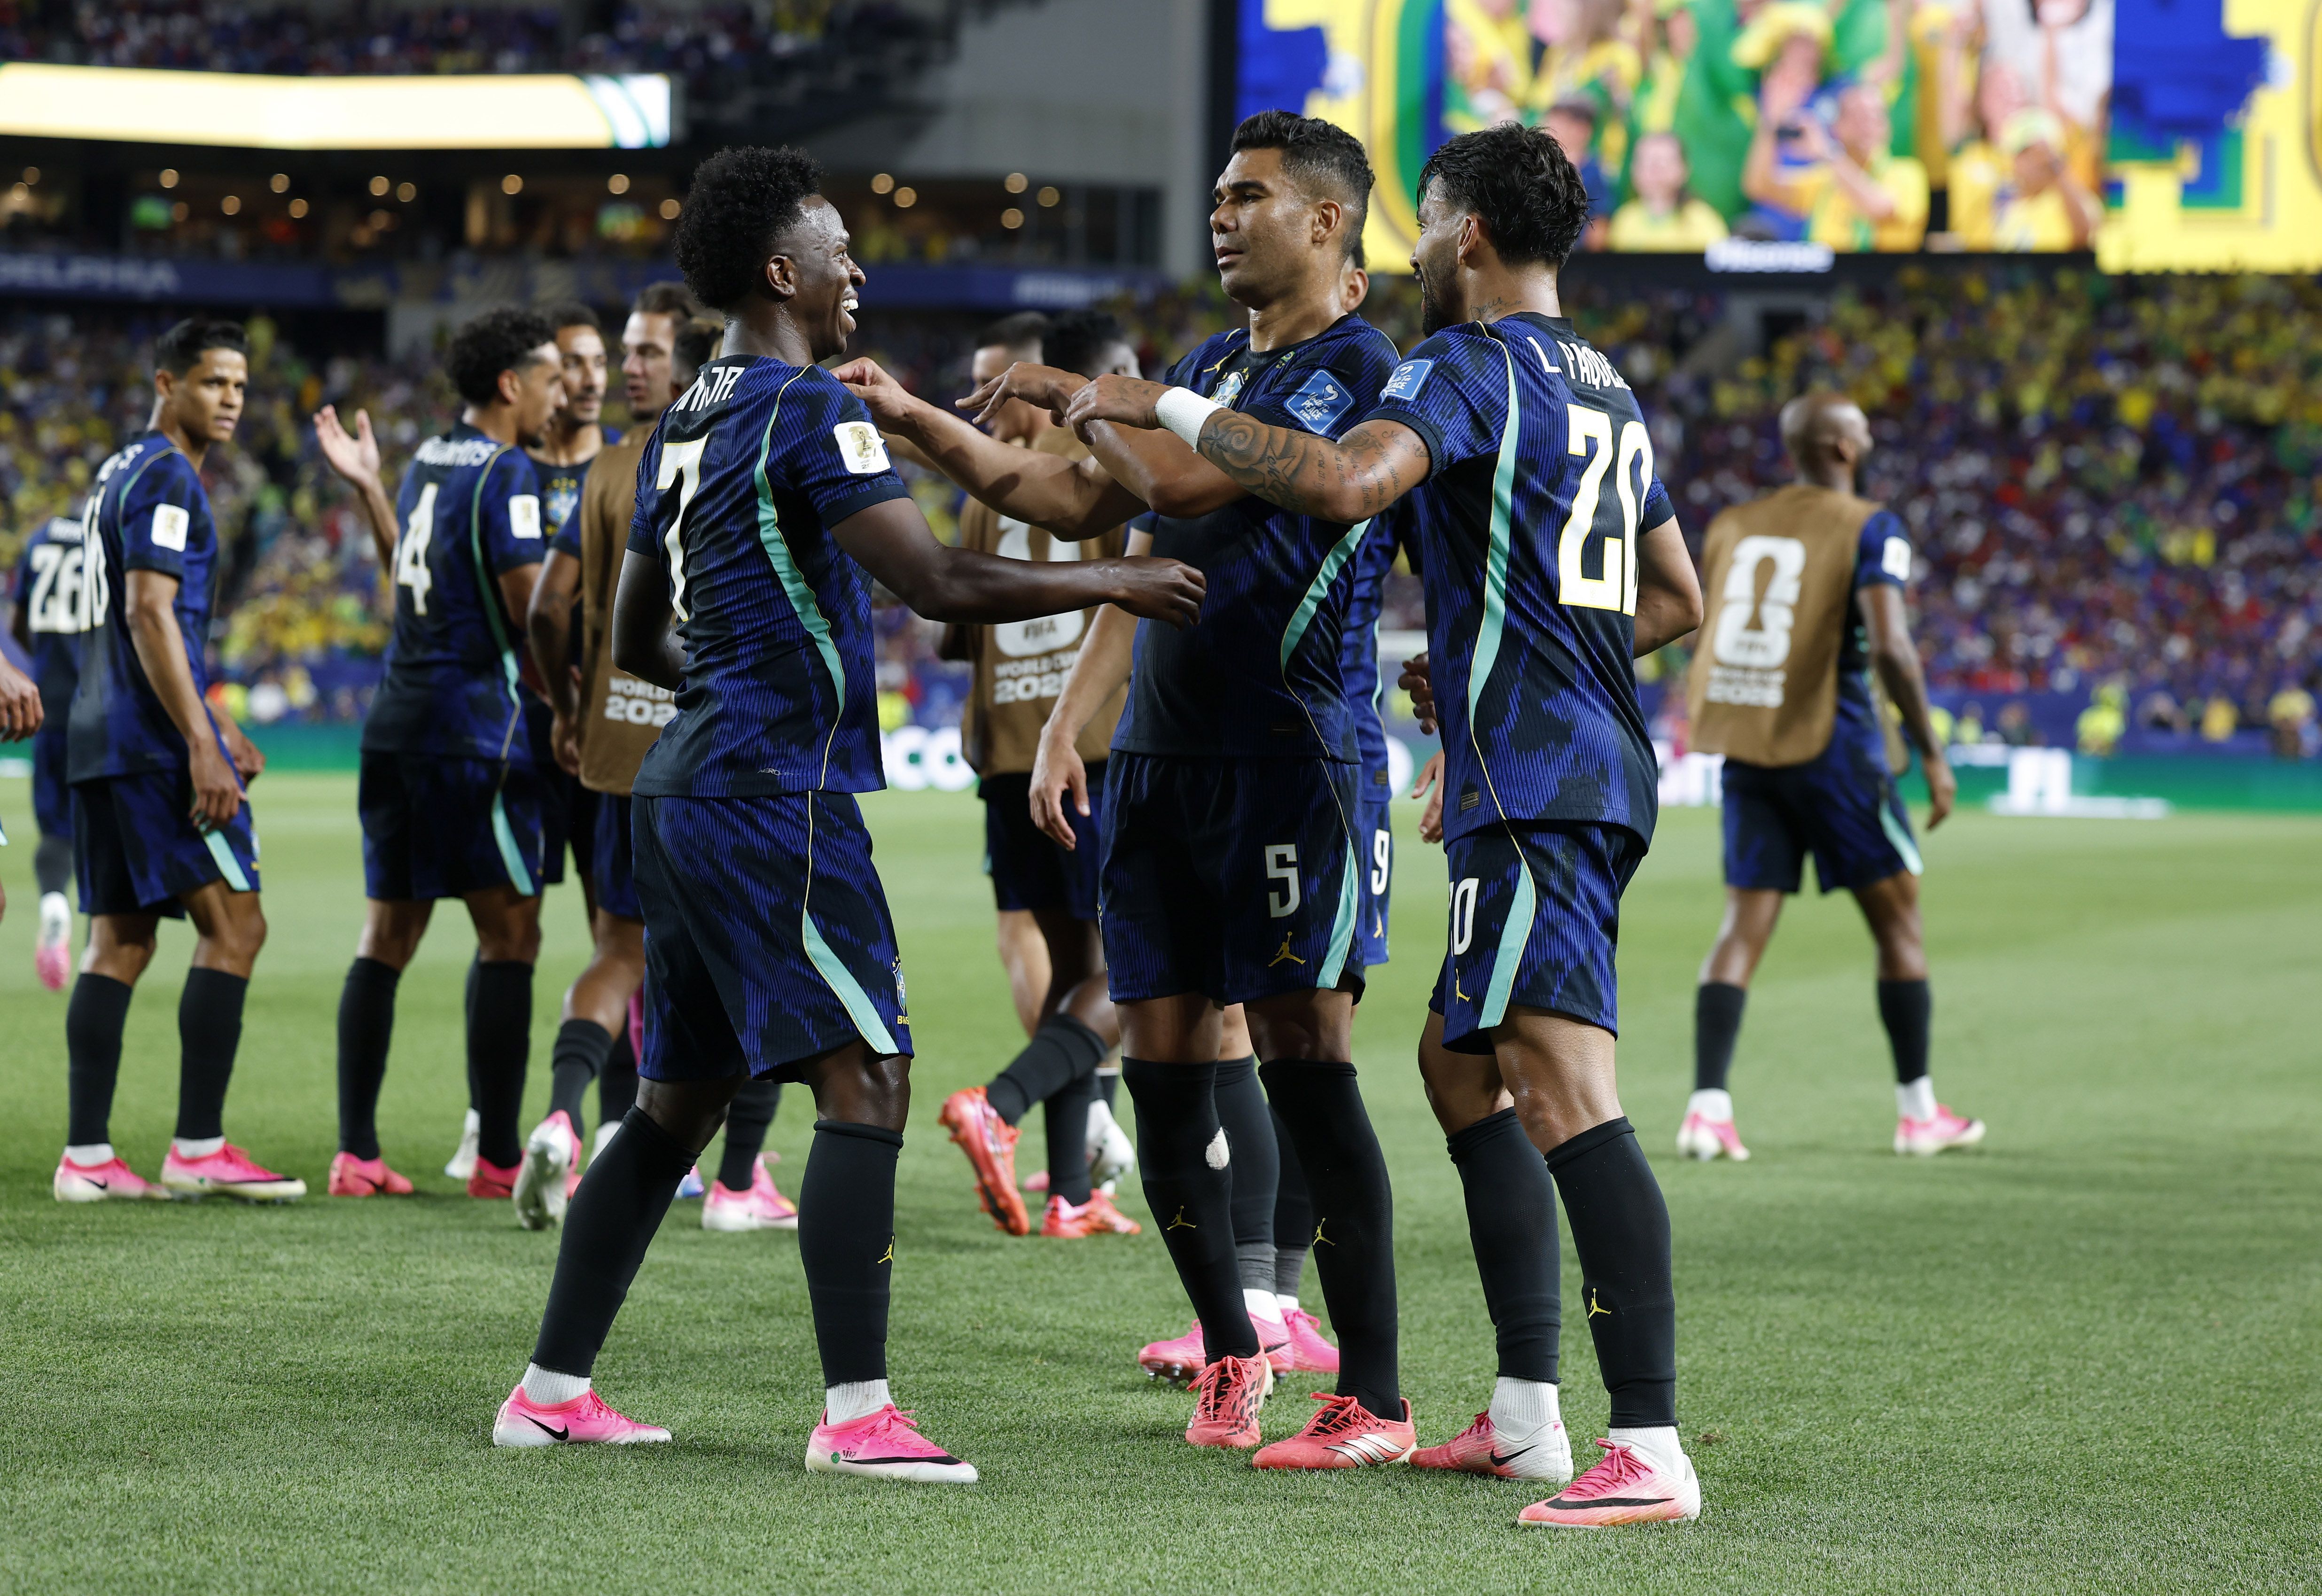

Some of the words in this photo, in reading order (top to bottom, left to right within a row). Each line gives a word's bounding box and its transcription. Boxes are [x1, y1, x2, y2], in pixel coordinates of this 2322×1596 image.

[1300, 410, 1311, 420] FIFA
[1301, 399, 1323, 420] PEACE
[657, 433, 709, 623] 7
[1558, 403, 1653, 616] 20
[397, 482, 439, 616] 4
[29, 544, 83, 634] 26
[994, 656, 1053, 678] WORLD
[1265, 843, 1301, 918] 5
[1371, 828, 1389, 895] 9
[1449, 878, 1480, 958] 0
